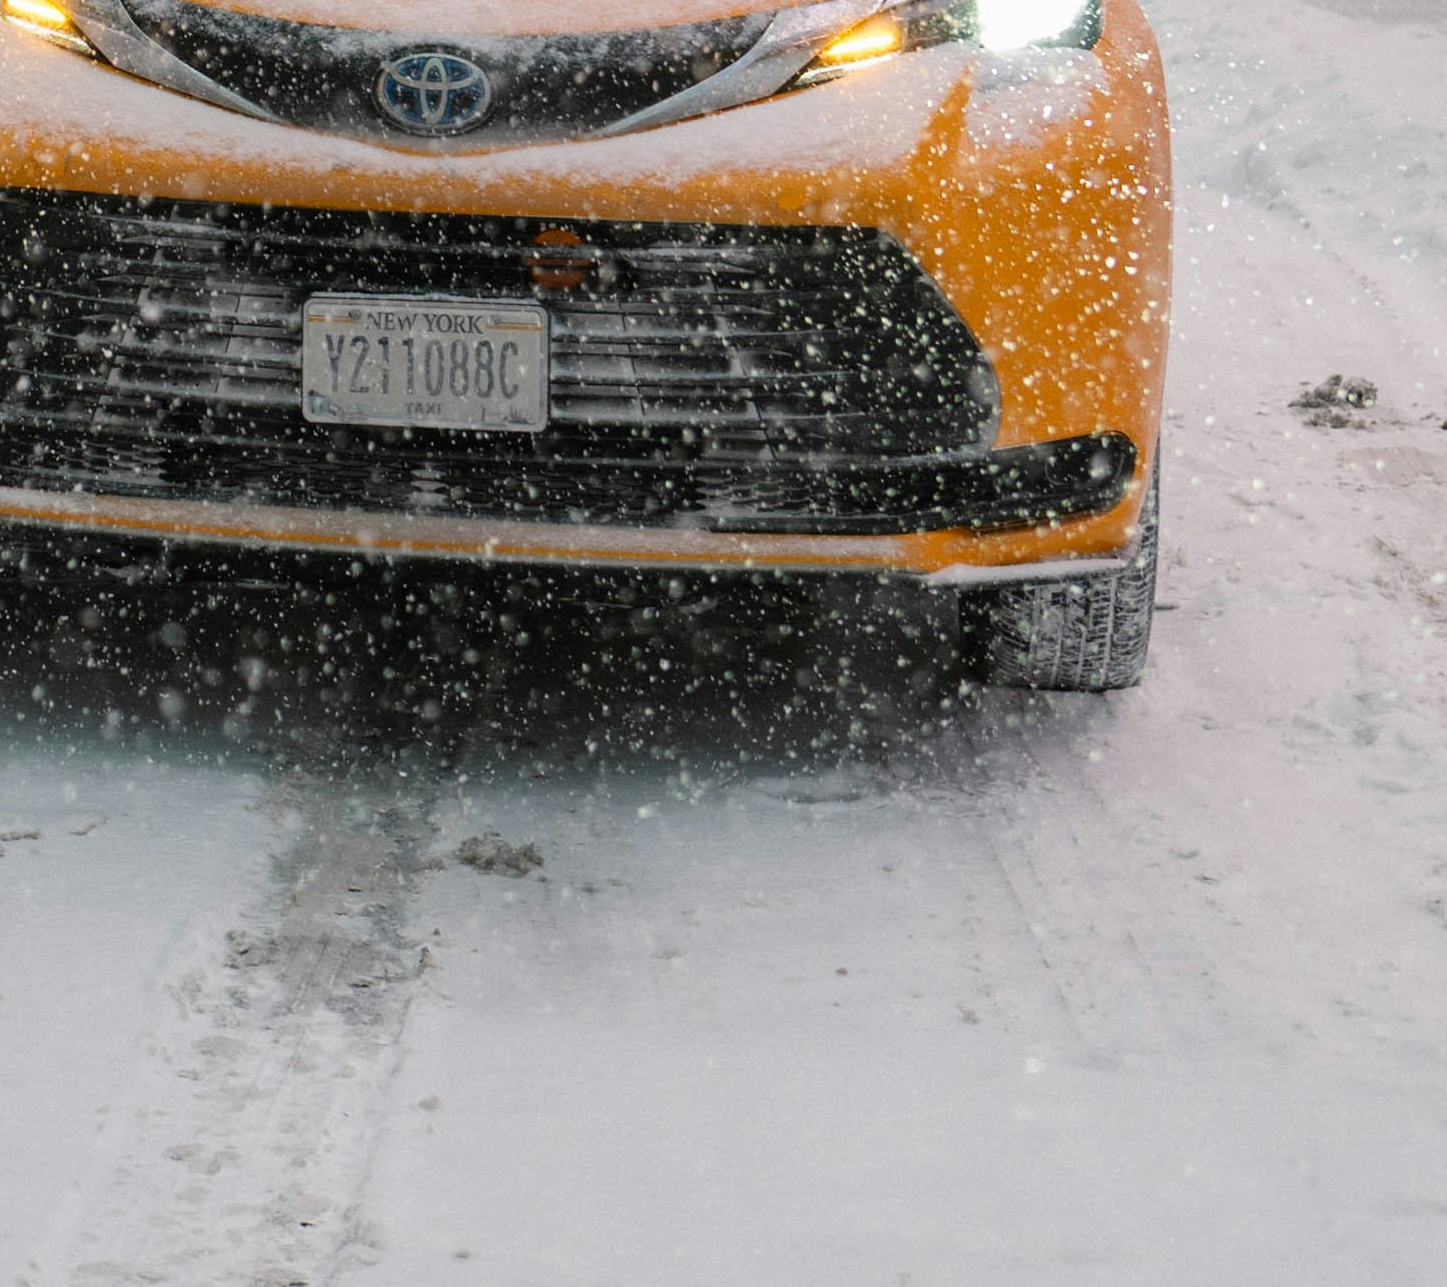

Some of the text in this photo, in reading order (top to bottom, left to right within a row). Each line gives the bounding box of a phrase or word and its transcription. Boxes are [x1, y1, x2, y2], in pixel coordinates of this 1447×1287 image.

[366, 311, 484, 334] NEW YORK
[324, 333, 520, 399] Y211088C
[407, 401, 442, 416] TAXI
